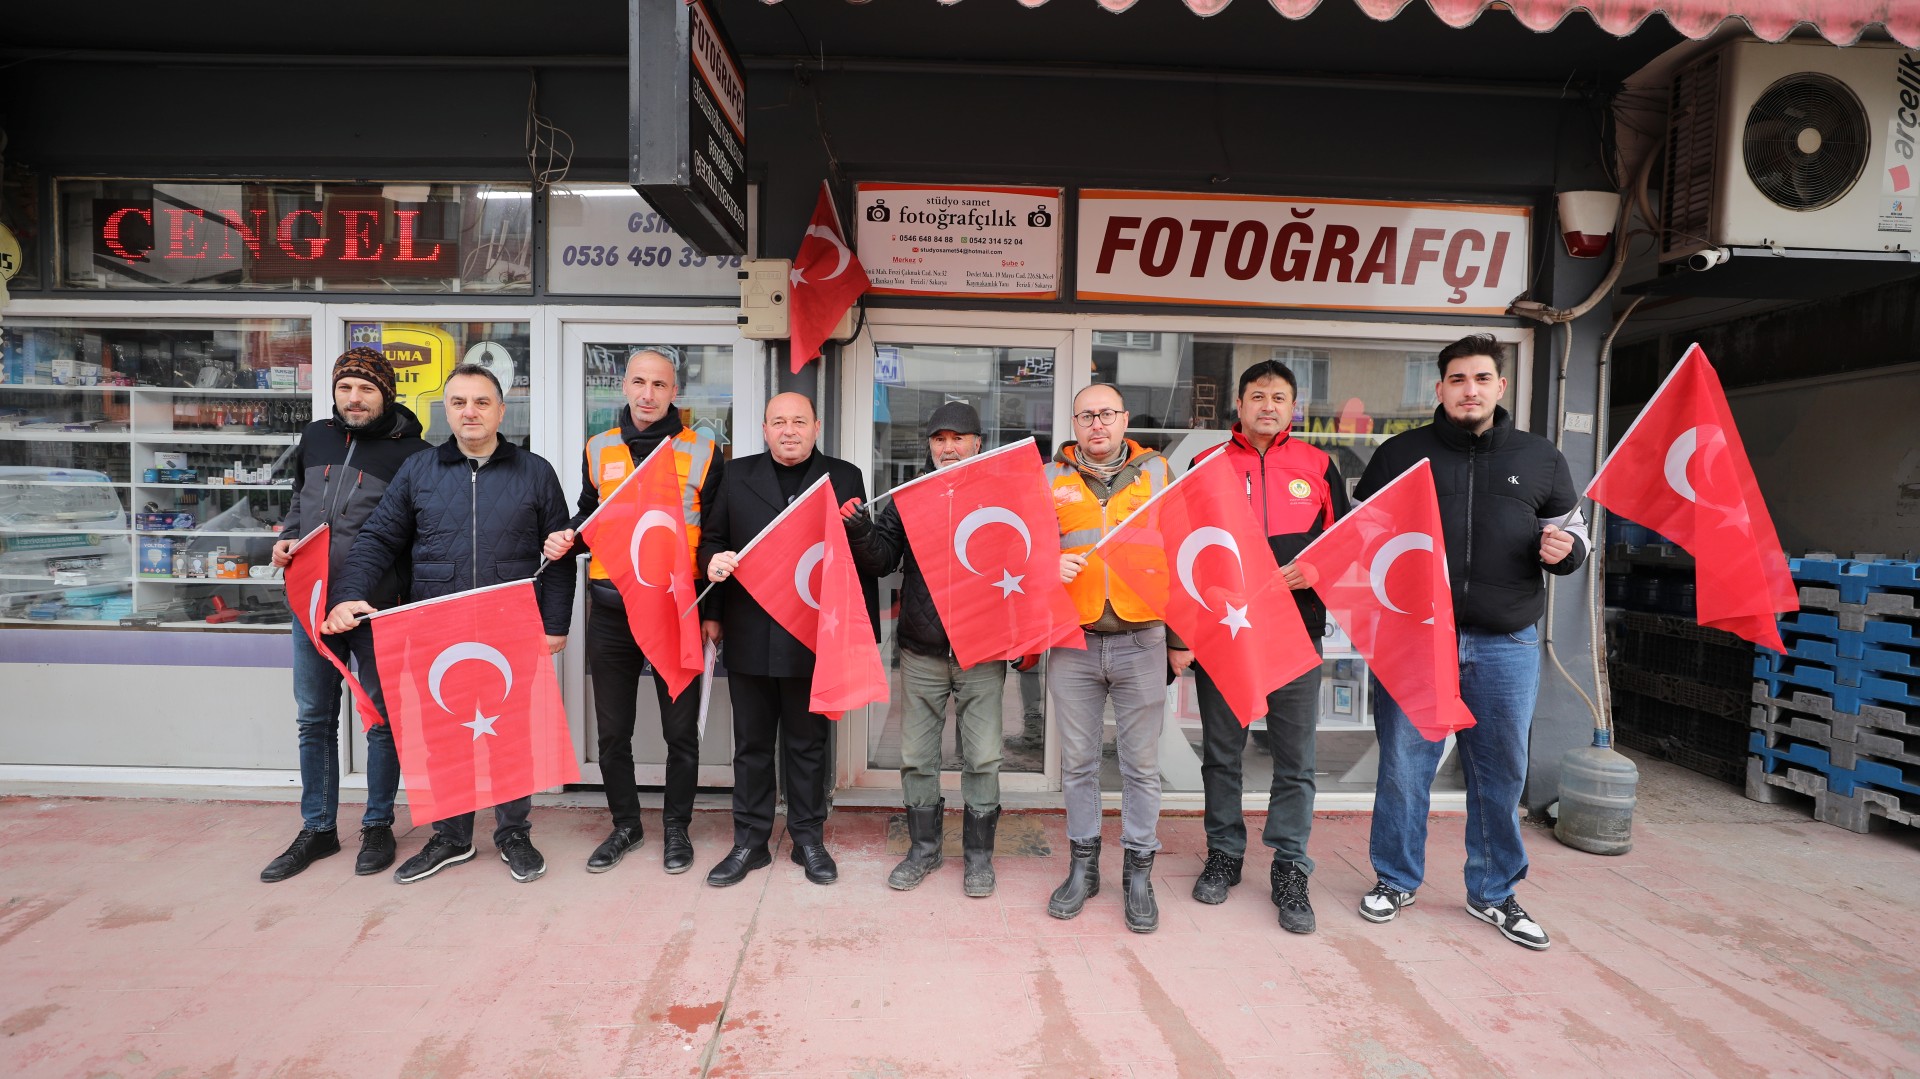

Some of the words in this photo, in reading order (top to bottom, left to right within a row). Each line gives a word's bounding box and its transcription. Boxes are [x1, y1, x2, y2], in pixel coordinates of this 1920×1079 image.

[692, 8, 744, 125] FOTOĞRAFÇI
[1894, 52, 1920, 160] arçelik
[926, 196, 959, 208] stüdyo
[962, 198, 991, 207] samet
[899, 205, 1017, 230] fotoğrafçılık
[102, 207, 441, 265] ÇENGEL
[899, 234, 917, 242] 0546
[918, 235, 932, 243] 648
[562, 245, 619, 267] 0536
[627, 246, 672, 267] 450
[892, 256, 917, 264] Merkez
[1001, 259, 1018, 267] Şube
[1096, 207, 1512, 305] FOTOĞRAFÇI
[382, 350, 424, 361] UMA
[394, 370, 420, 383] LİT
